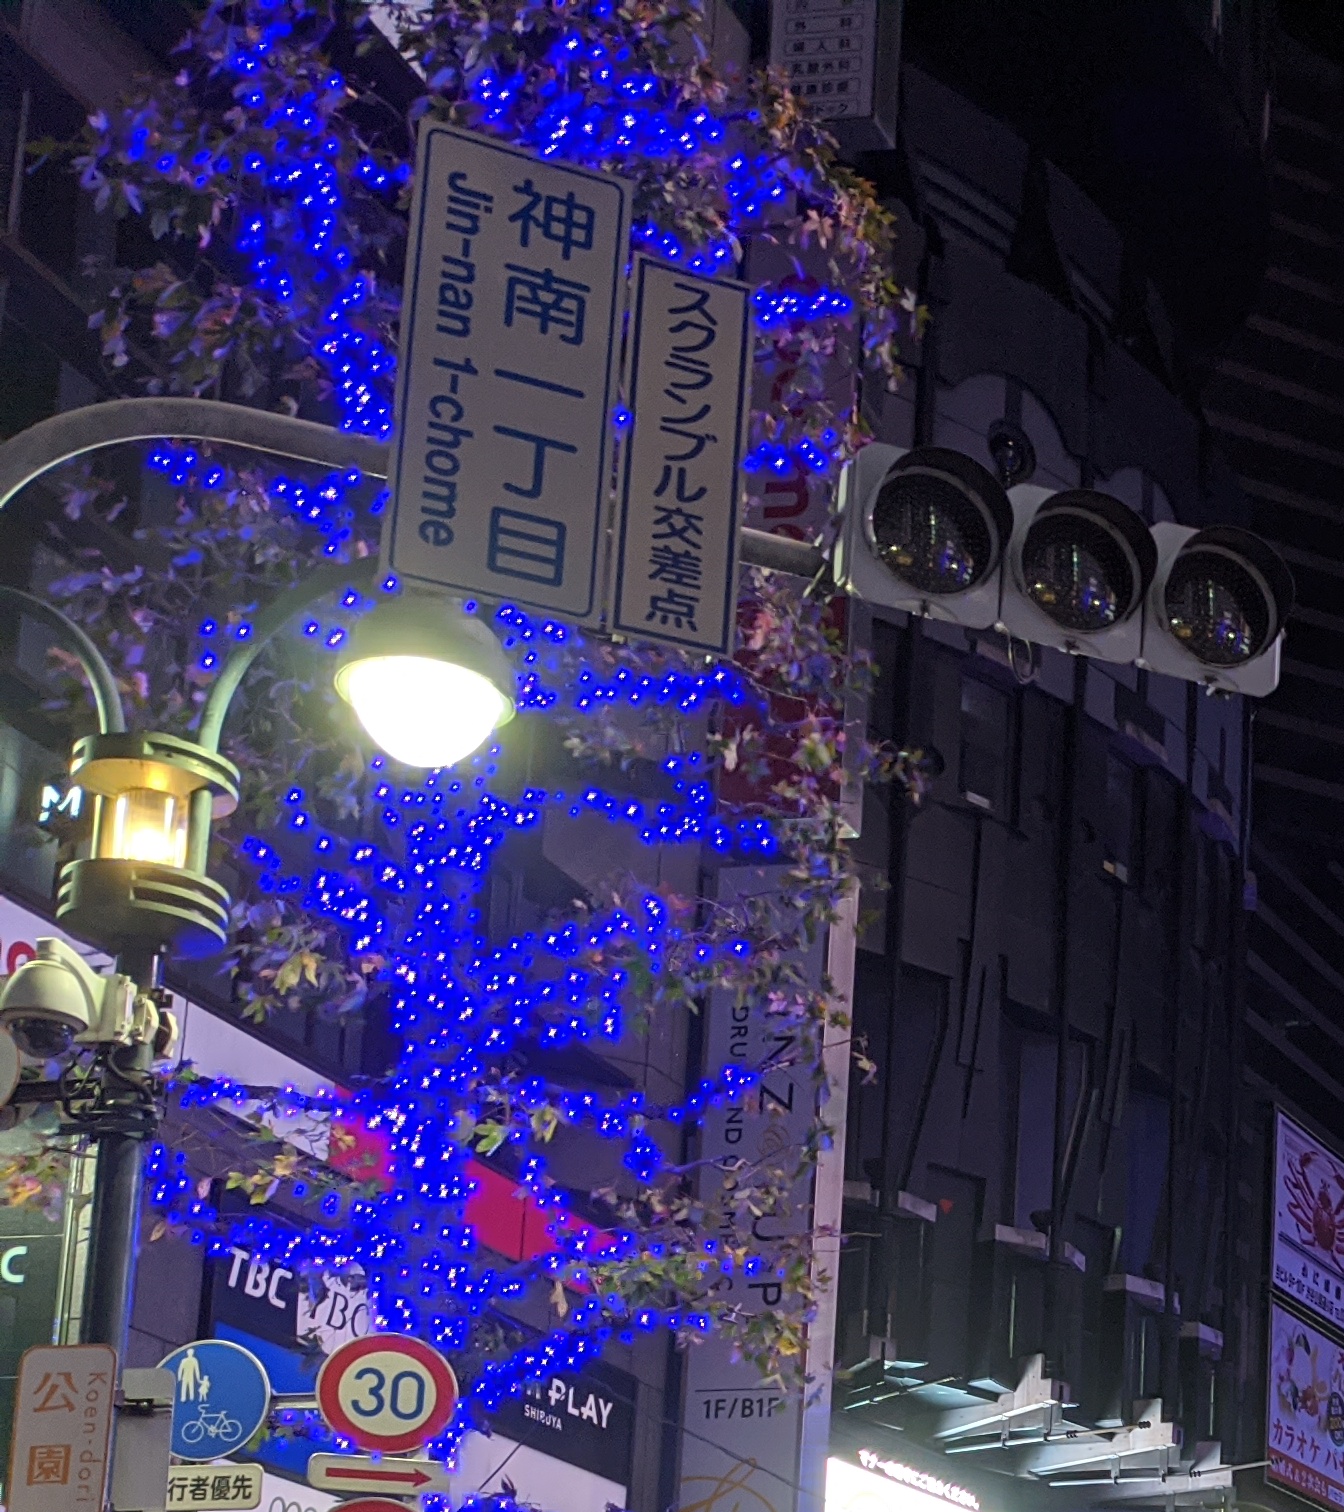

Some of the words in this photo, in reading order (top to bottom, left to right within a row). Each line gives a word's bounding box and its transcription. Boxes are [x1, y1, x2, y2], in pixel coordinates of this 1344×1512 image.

[436, 171, 494, 338] Jin-nan
[487, 179, 596, 588] 神南一丁目
[419, 357, 479, 548] 1-chome
[646, 281, 719, 632] スクランブル交差点
[228, 1246, 293, 1309] TBC
[351, 1367, 425, 1421] 30
[548, 1378, 614, 1429] PLAY
[702, 1397, 780, 1420] 1F/B1F
[1272, 1417, 1320, 1463] カラオケ
